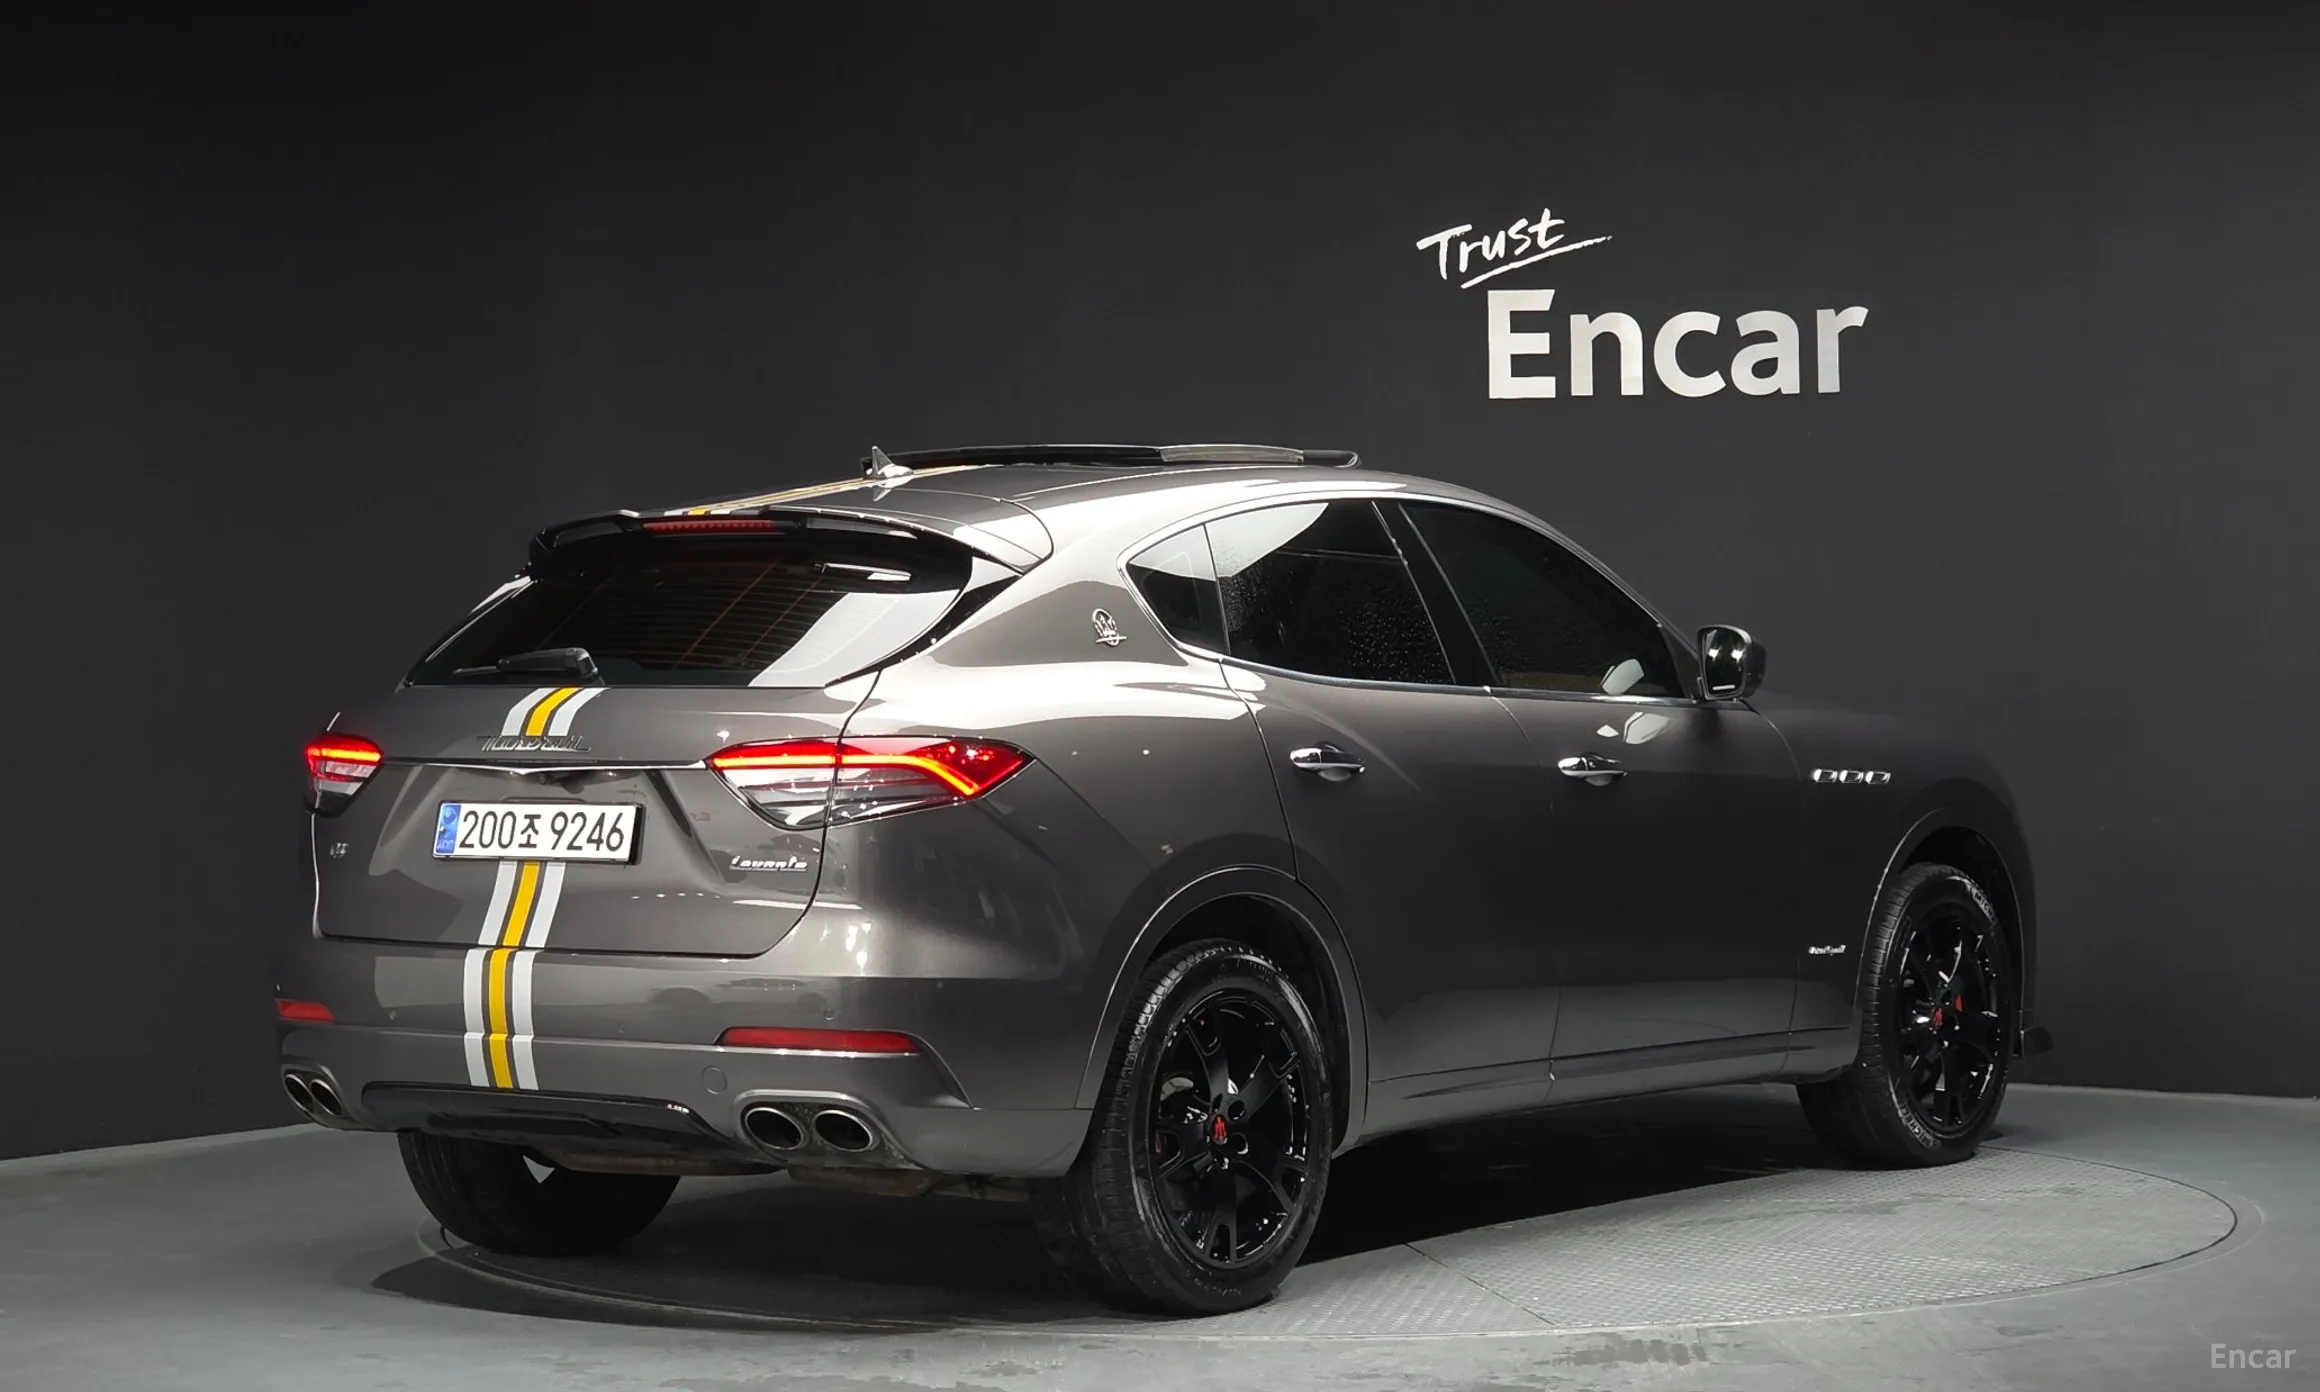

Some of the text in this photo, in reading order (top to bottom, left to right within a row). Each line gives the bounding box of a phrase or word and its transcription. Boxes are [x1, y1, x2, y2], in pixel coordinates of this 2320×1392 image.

[1416, 208, 1566, 280] Trust
[1488, 289, 1869, 399] Encar
[459, 810, 625, 852] 200조 9246
